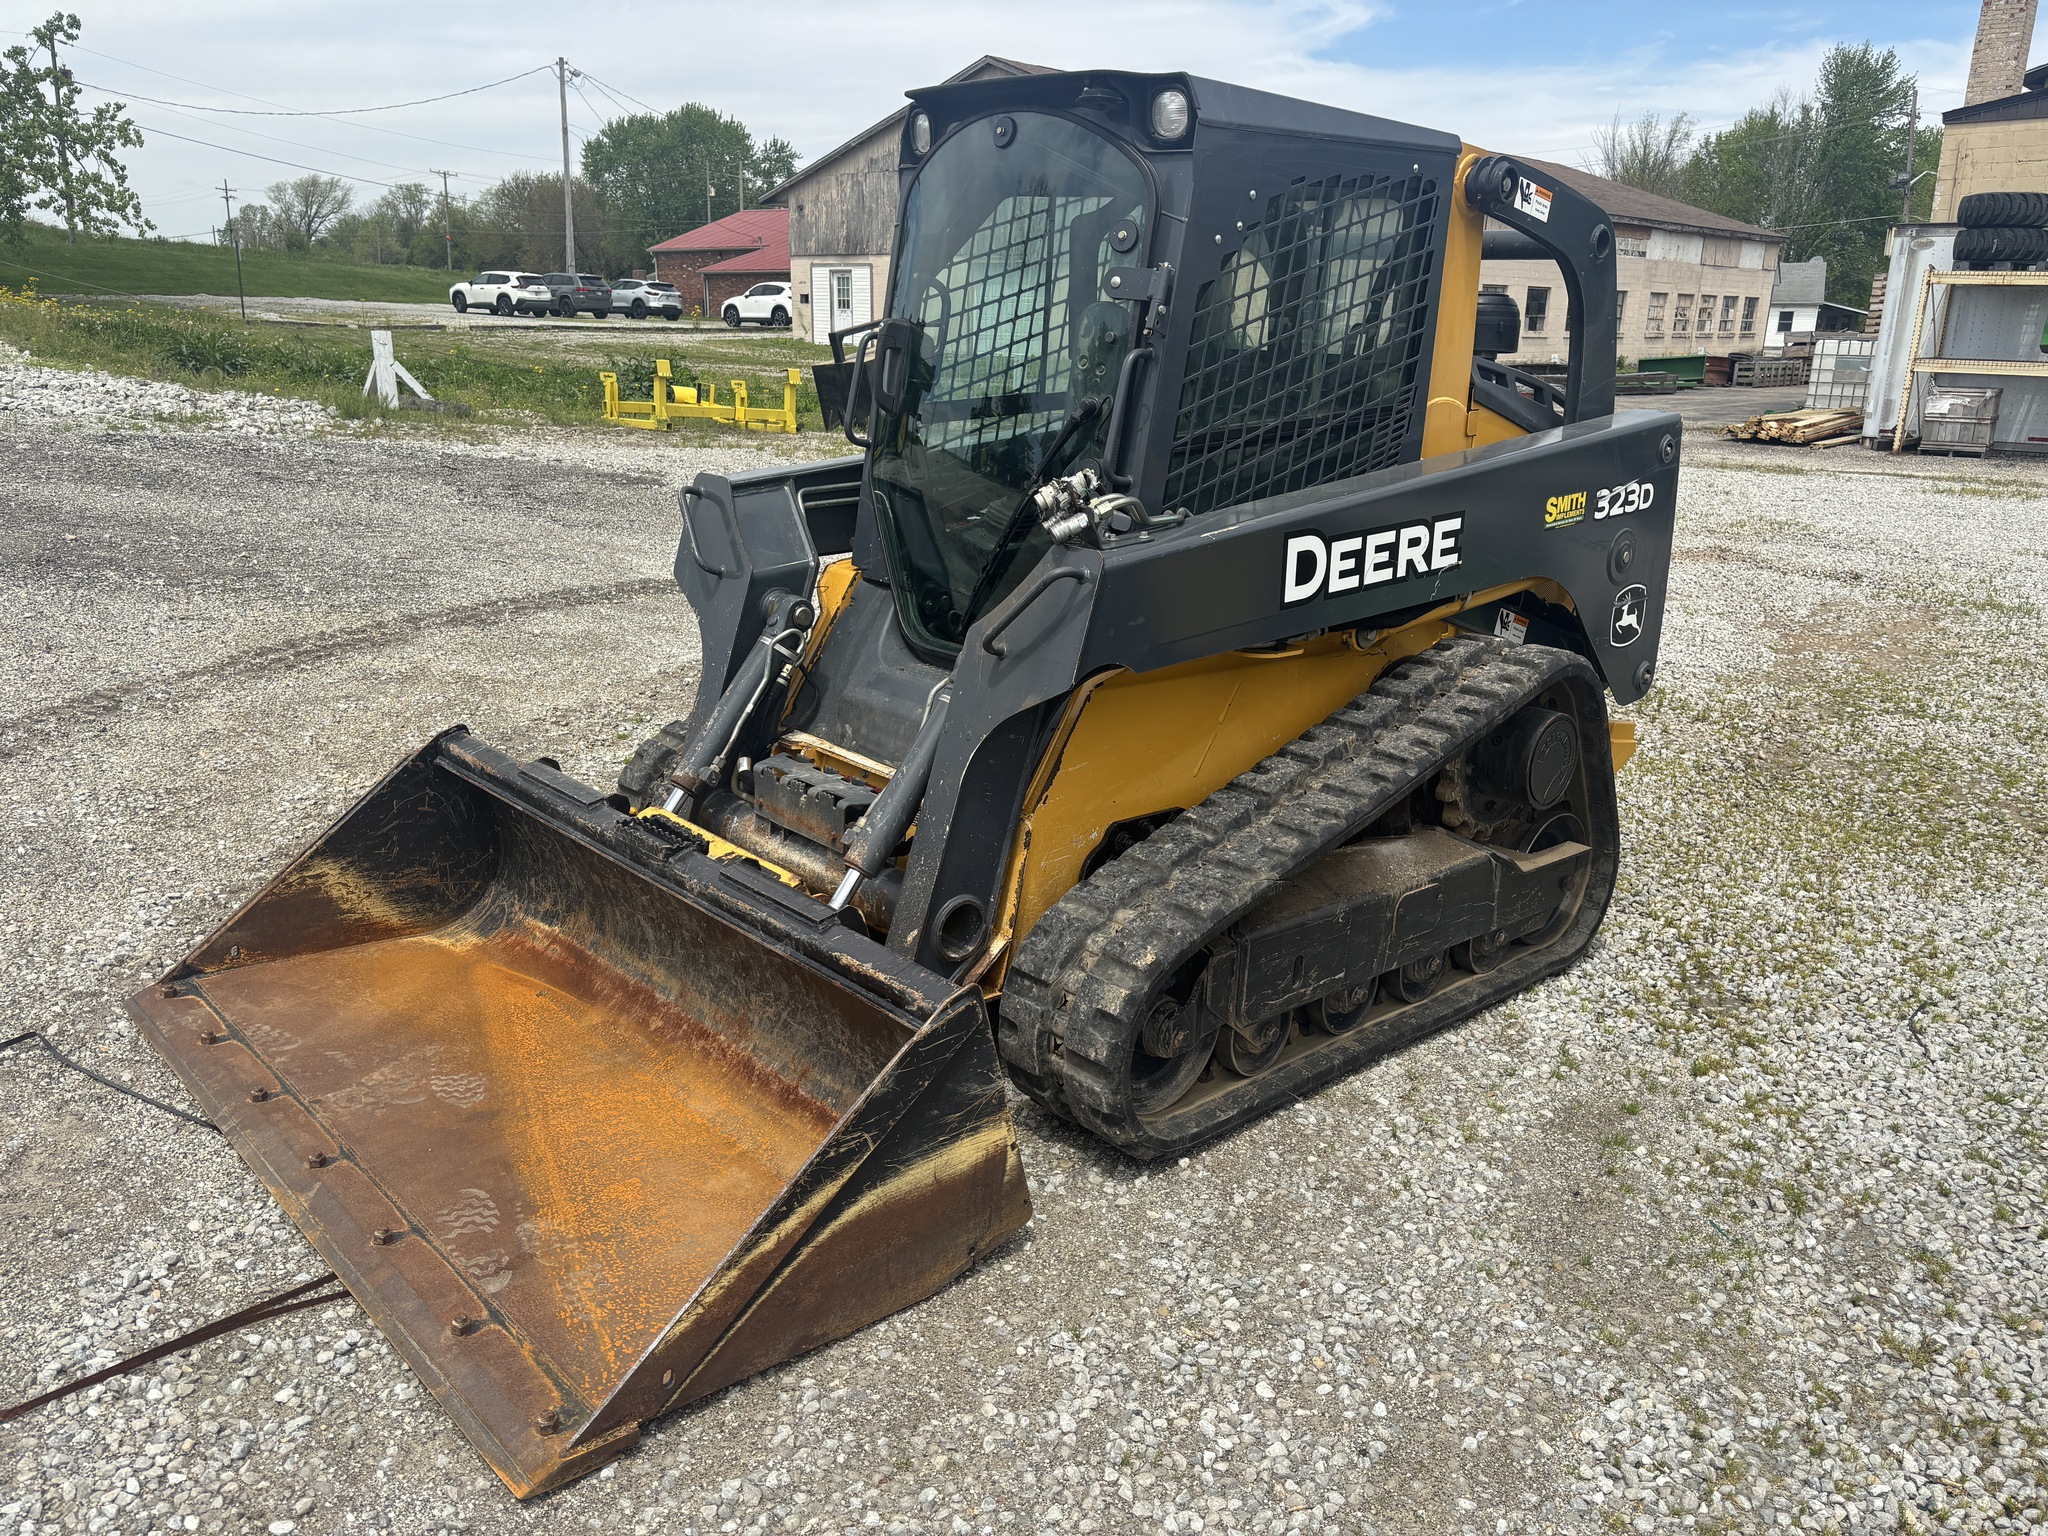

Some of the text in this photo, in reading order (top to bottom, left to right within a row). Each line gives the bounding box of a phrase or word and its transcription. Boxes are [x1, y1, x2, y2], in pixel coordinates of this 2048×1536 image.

[1545, 491, 1587, 523] SMITH
[1594, 482, 1655, 520] 323D
[1284, 517, 1462, 604] DEERE
